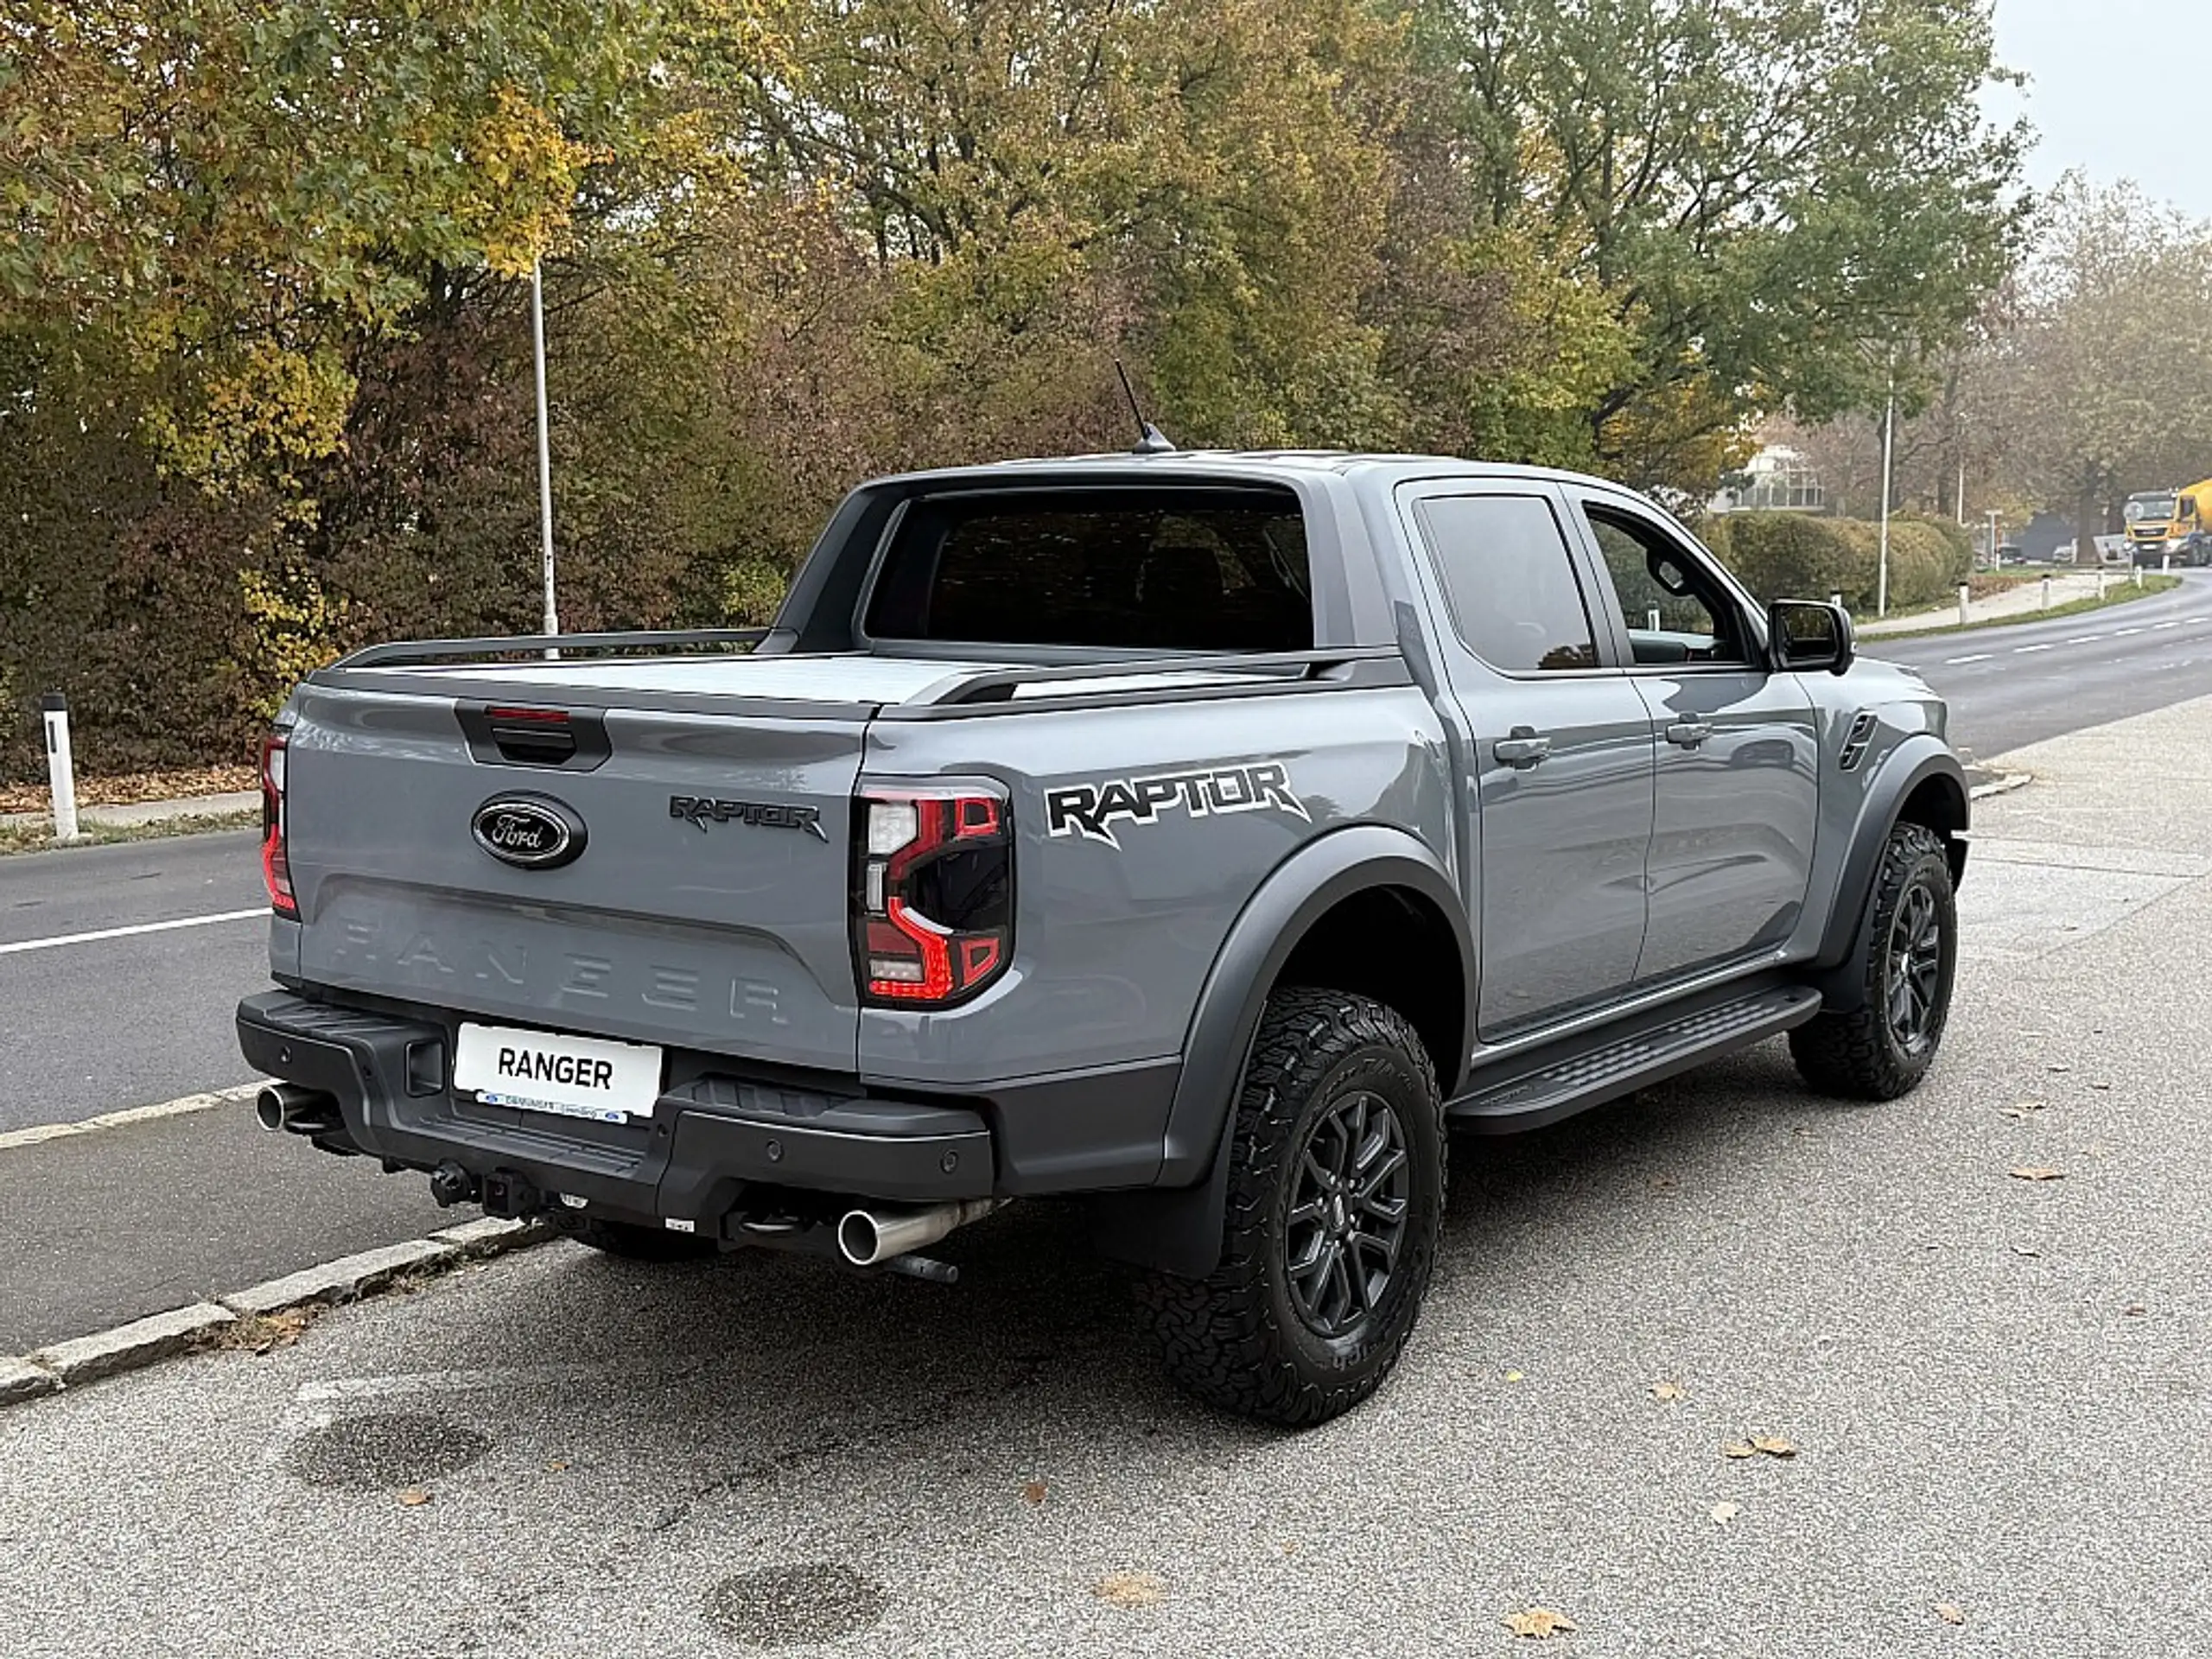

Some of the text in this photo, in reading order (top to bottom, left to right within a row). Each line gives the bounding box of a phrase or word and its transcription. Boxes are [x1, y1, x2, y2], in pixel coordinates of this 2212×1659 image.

[670, 795, 830, 843] RAPTOR
[1044, 760, 1313, 852] RAPTOR
[492, 814, 543, 849] Ford
[499, 1047, 613, 1090] RANGER
